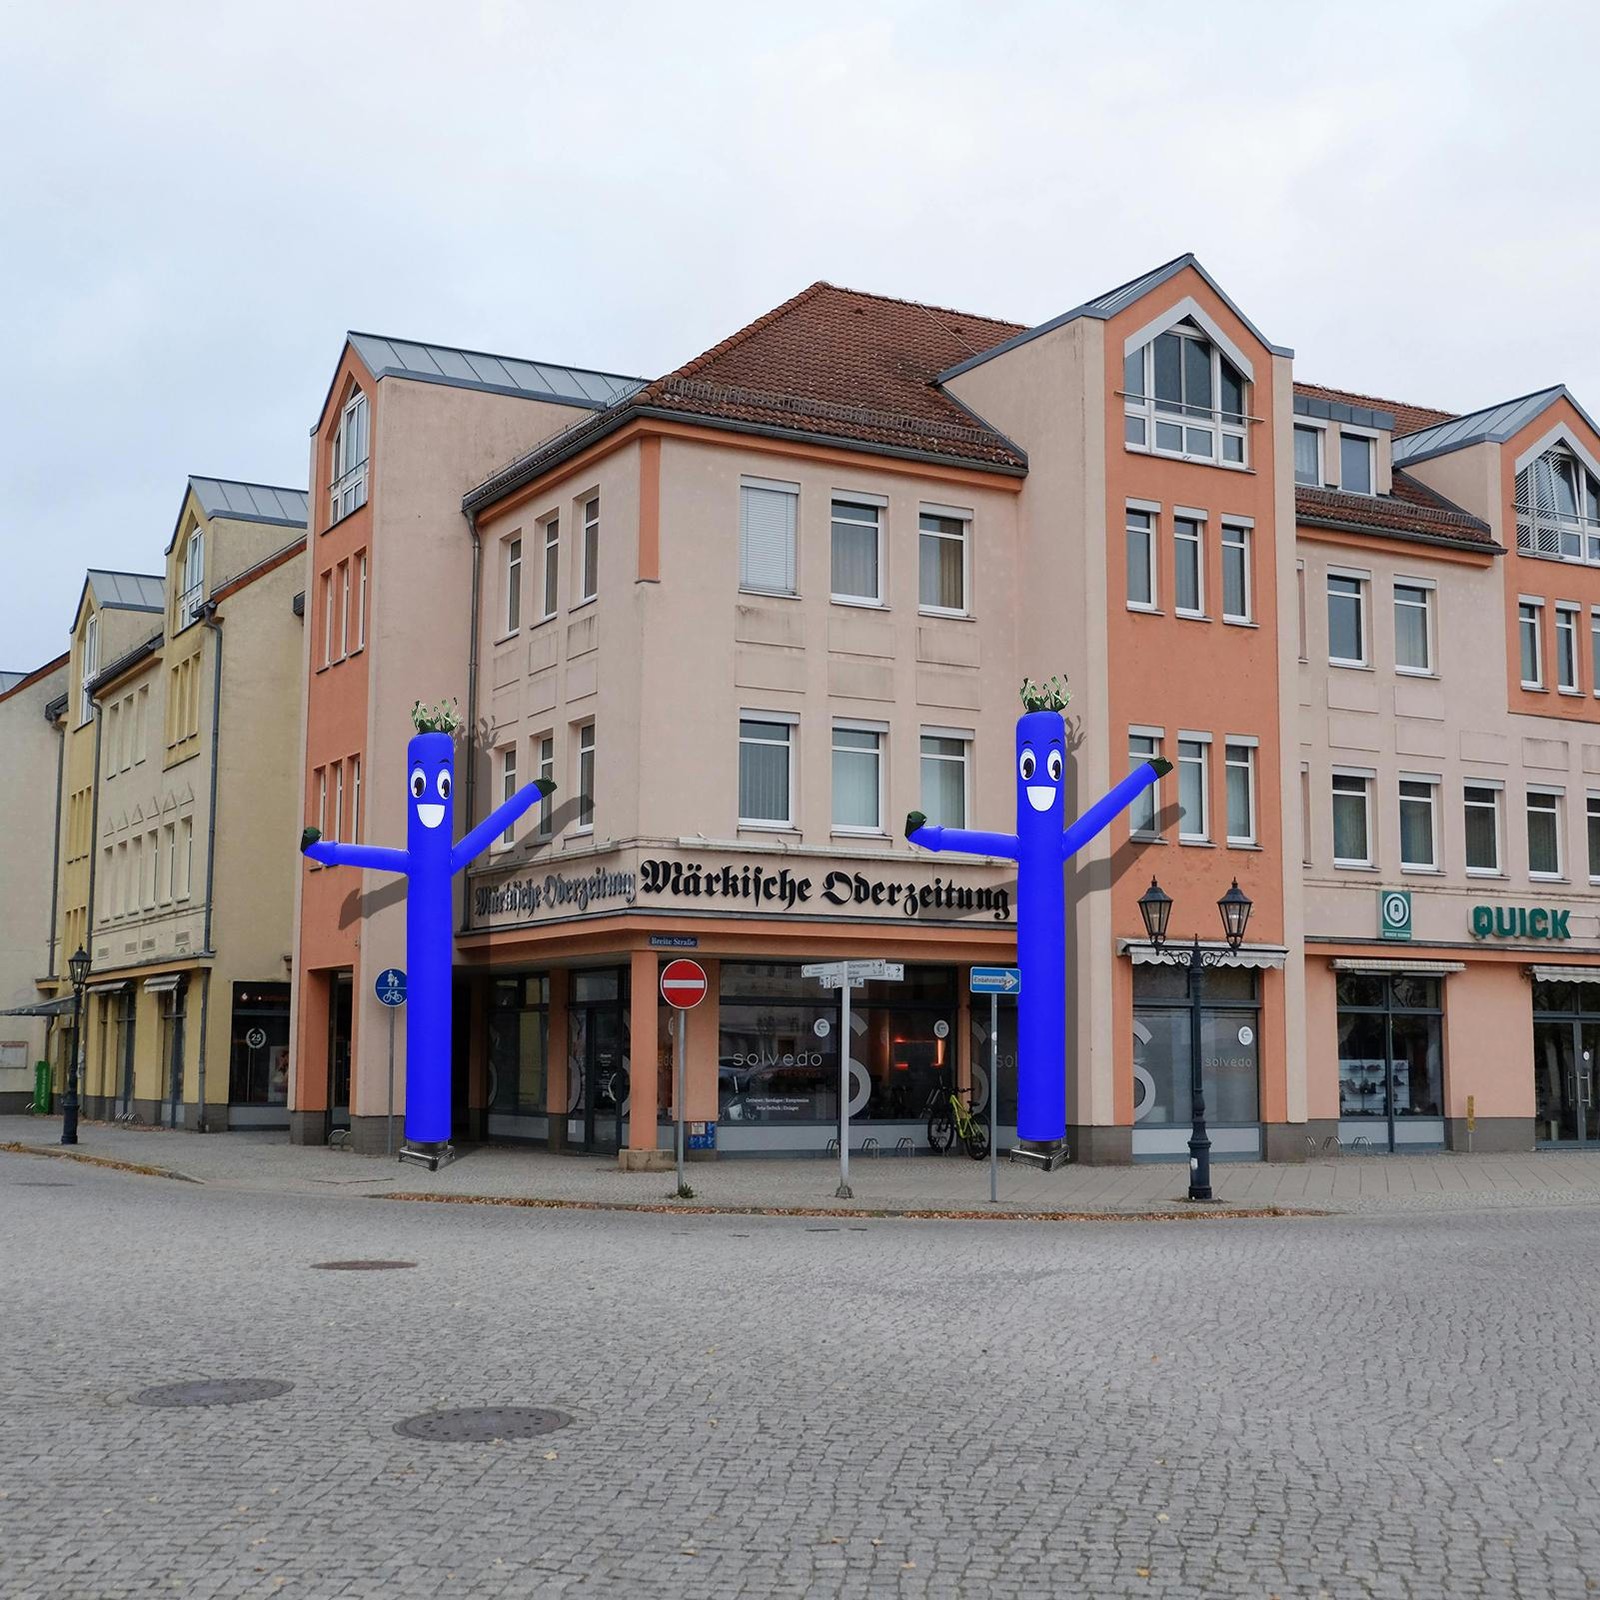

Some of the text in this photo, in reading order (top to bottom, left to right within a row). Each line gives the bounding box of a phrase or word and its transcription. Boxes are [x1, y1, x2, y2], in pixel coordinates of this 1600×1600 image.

[543, 866, 637, 911] Oderzeitung
[820, 870, 1010, 921] Oderzeitung
[1473, 905, 1571, 939] QUICK
[651, 936, 673, 946] Breite
[732, 1050, 823, 1067] solvedo
[1205, 1056, 1252, 1068] solvedo
